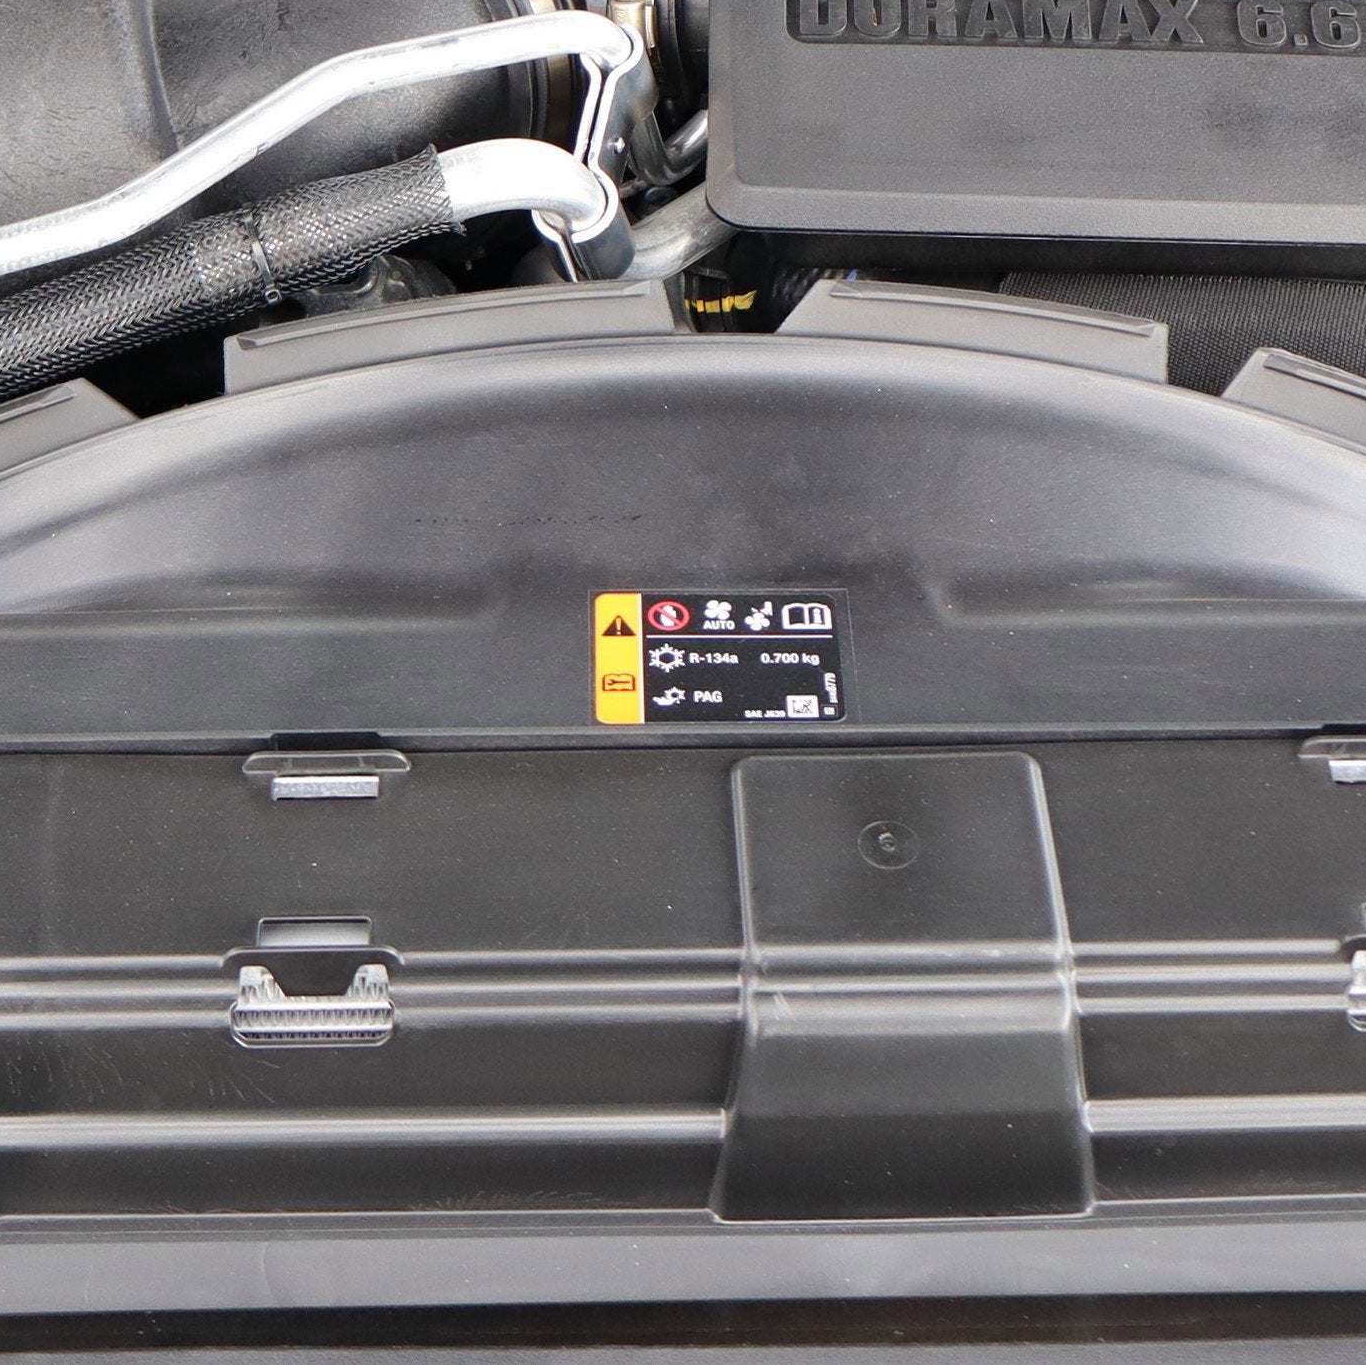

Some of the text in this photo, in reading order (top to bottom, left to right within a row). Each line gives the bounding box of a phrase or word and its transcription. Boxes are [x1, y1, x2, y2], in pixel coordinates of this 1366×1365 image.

[703, 620, 735, 630] AUTO
[689, 653, 820, 666] R-134a 0.700 kg
[693, 690, 723, 703] PAG
